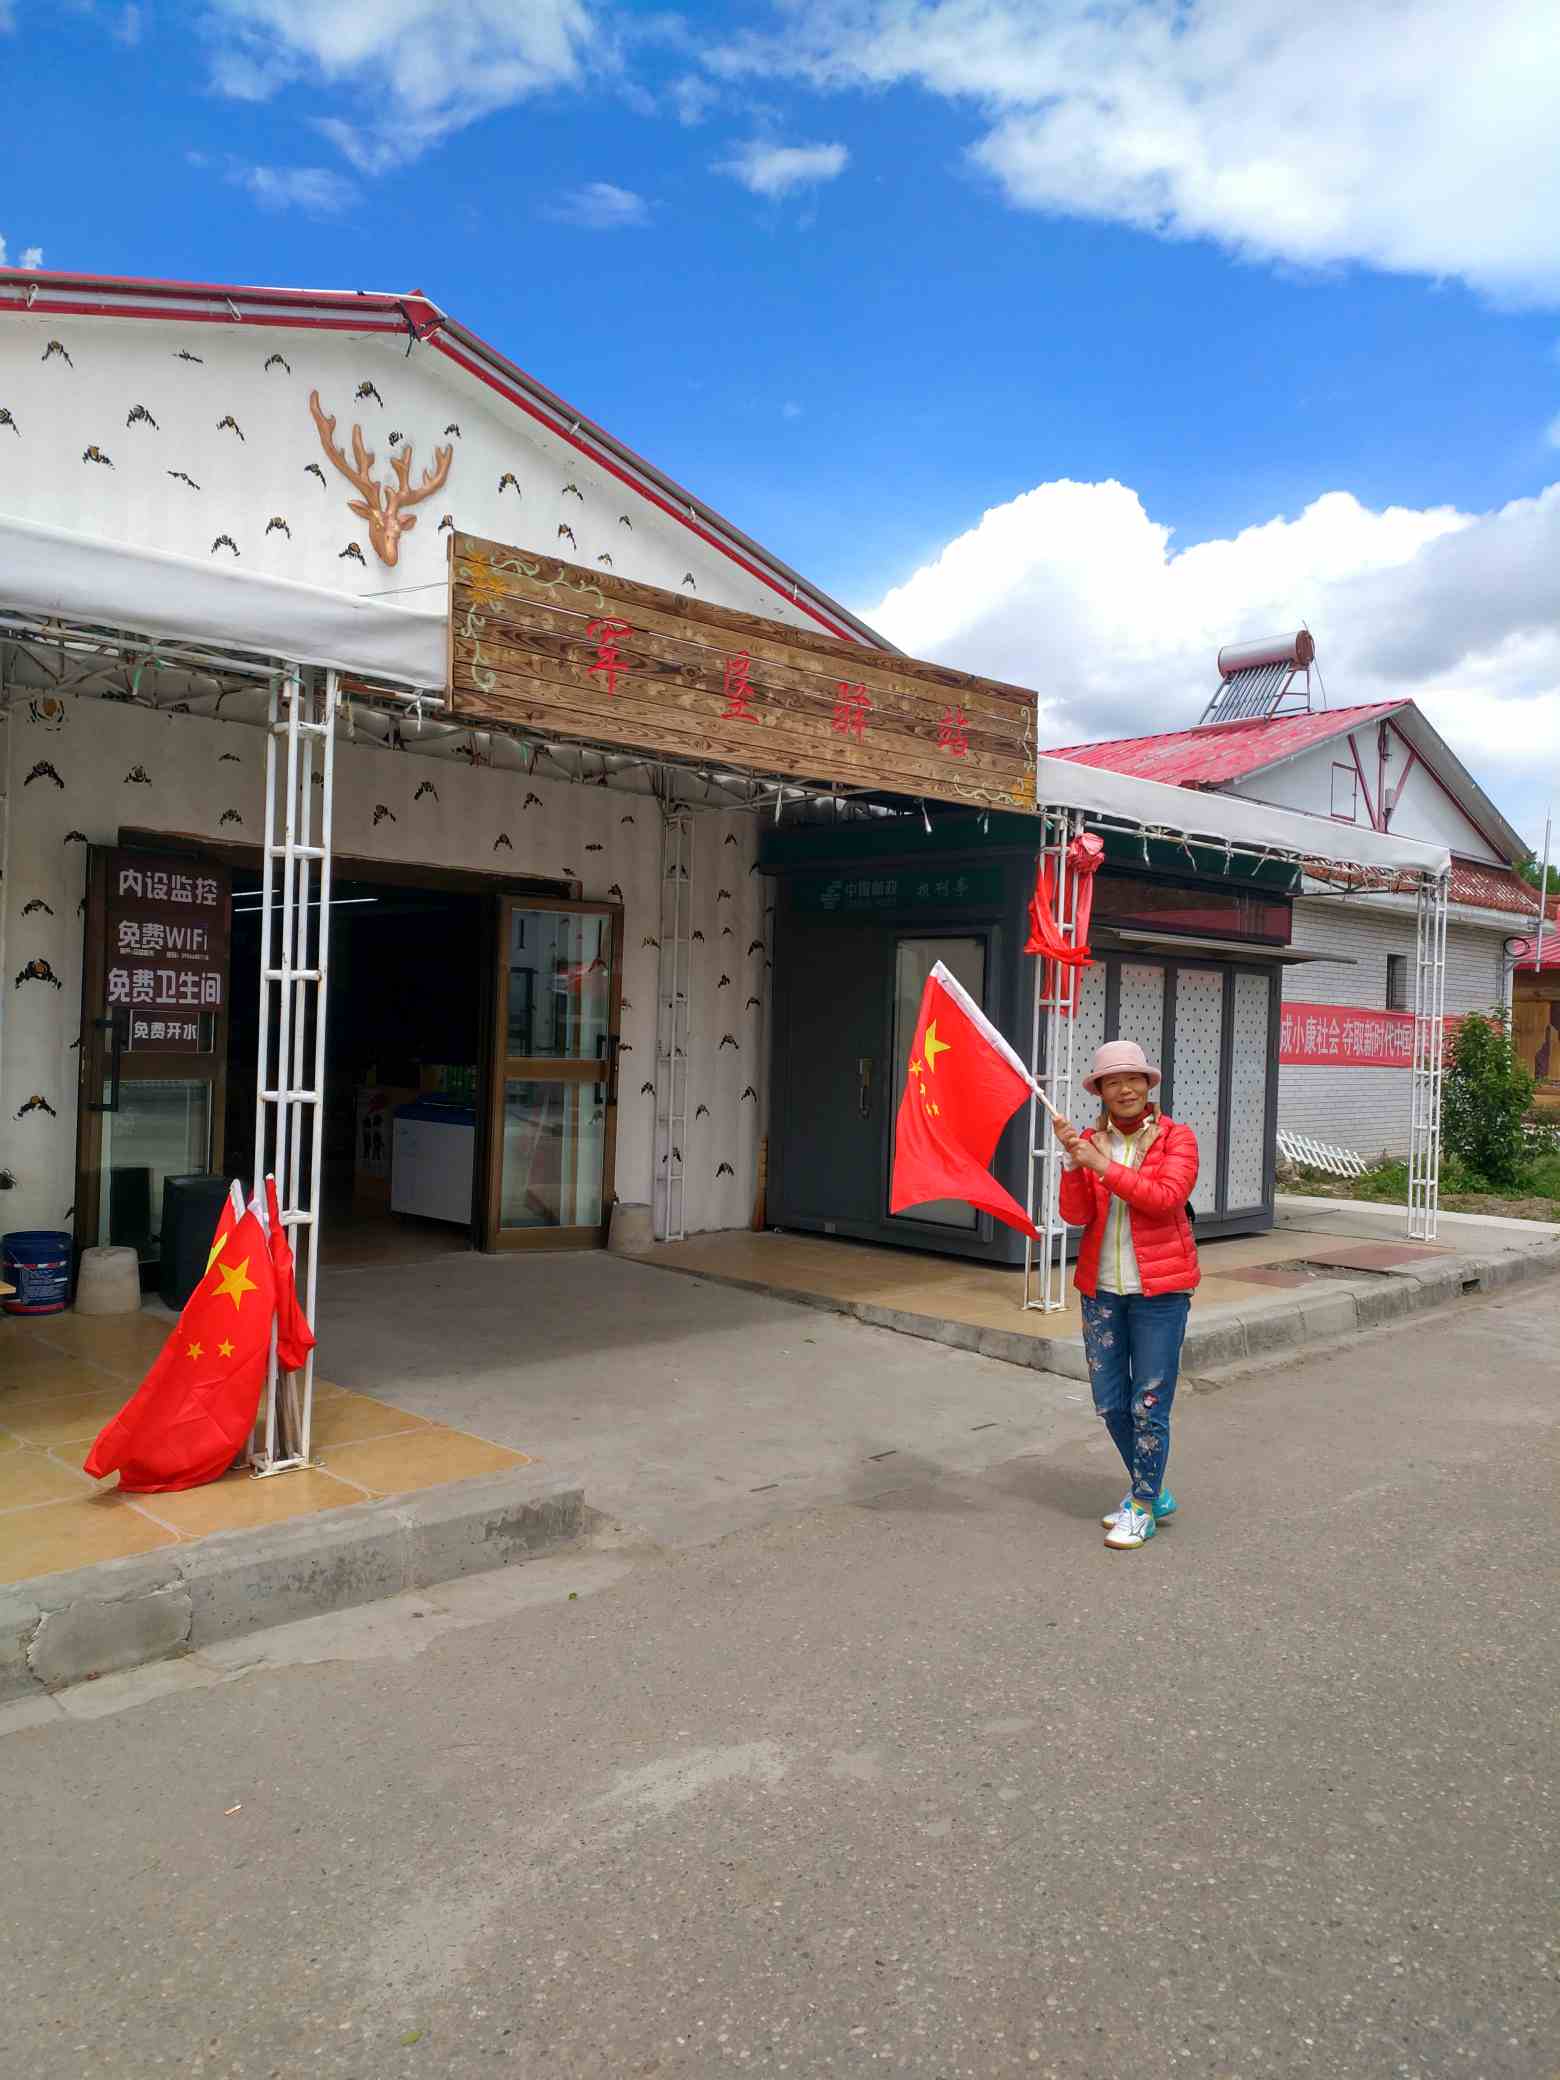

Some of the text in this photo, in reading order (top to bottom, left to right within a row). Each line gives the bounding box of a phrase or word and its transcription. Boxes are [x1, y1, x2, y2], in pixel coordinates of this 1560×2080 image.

[119, 869, 217, 905] 内设监控
[108, 967, 222, 1005] 免费卫生间
[134, 1021, 198, 1041] 免费开水
[1281, 1013, 1340, 1055] 成小康社会
